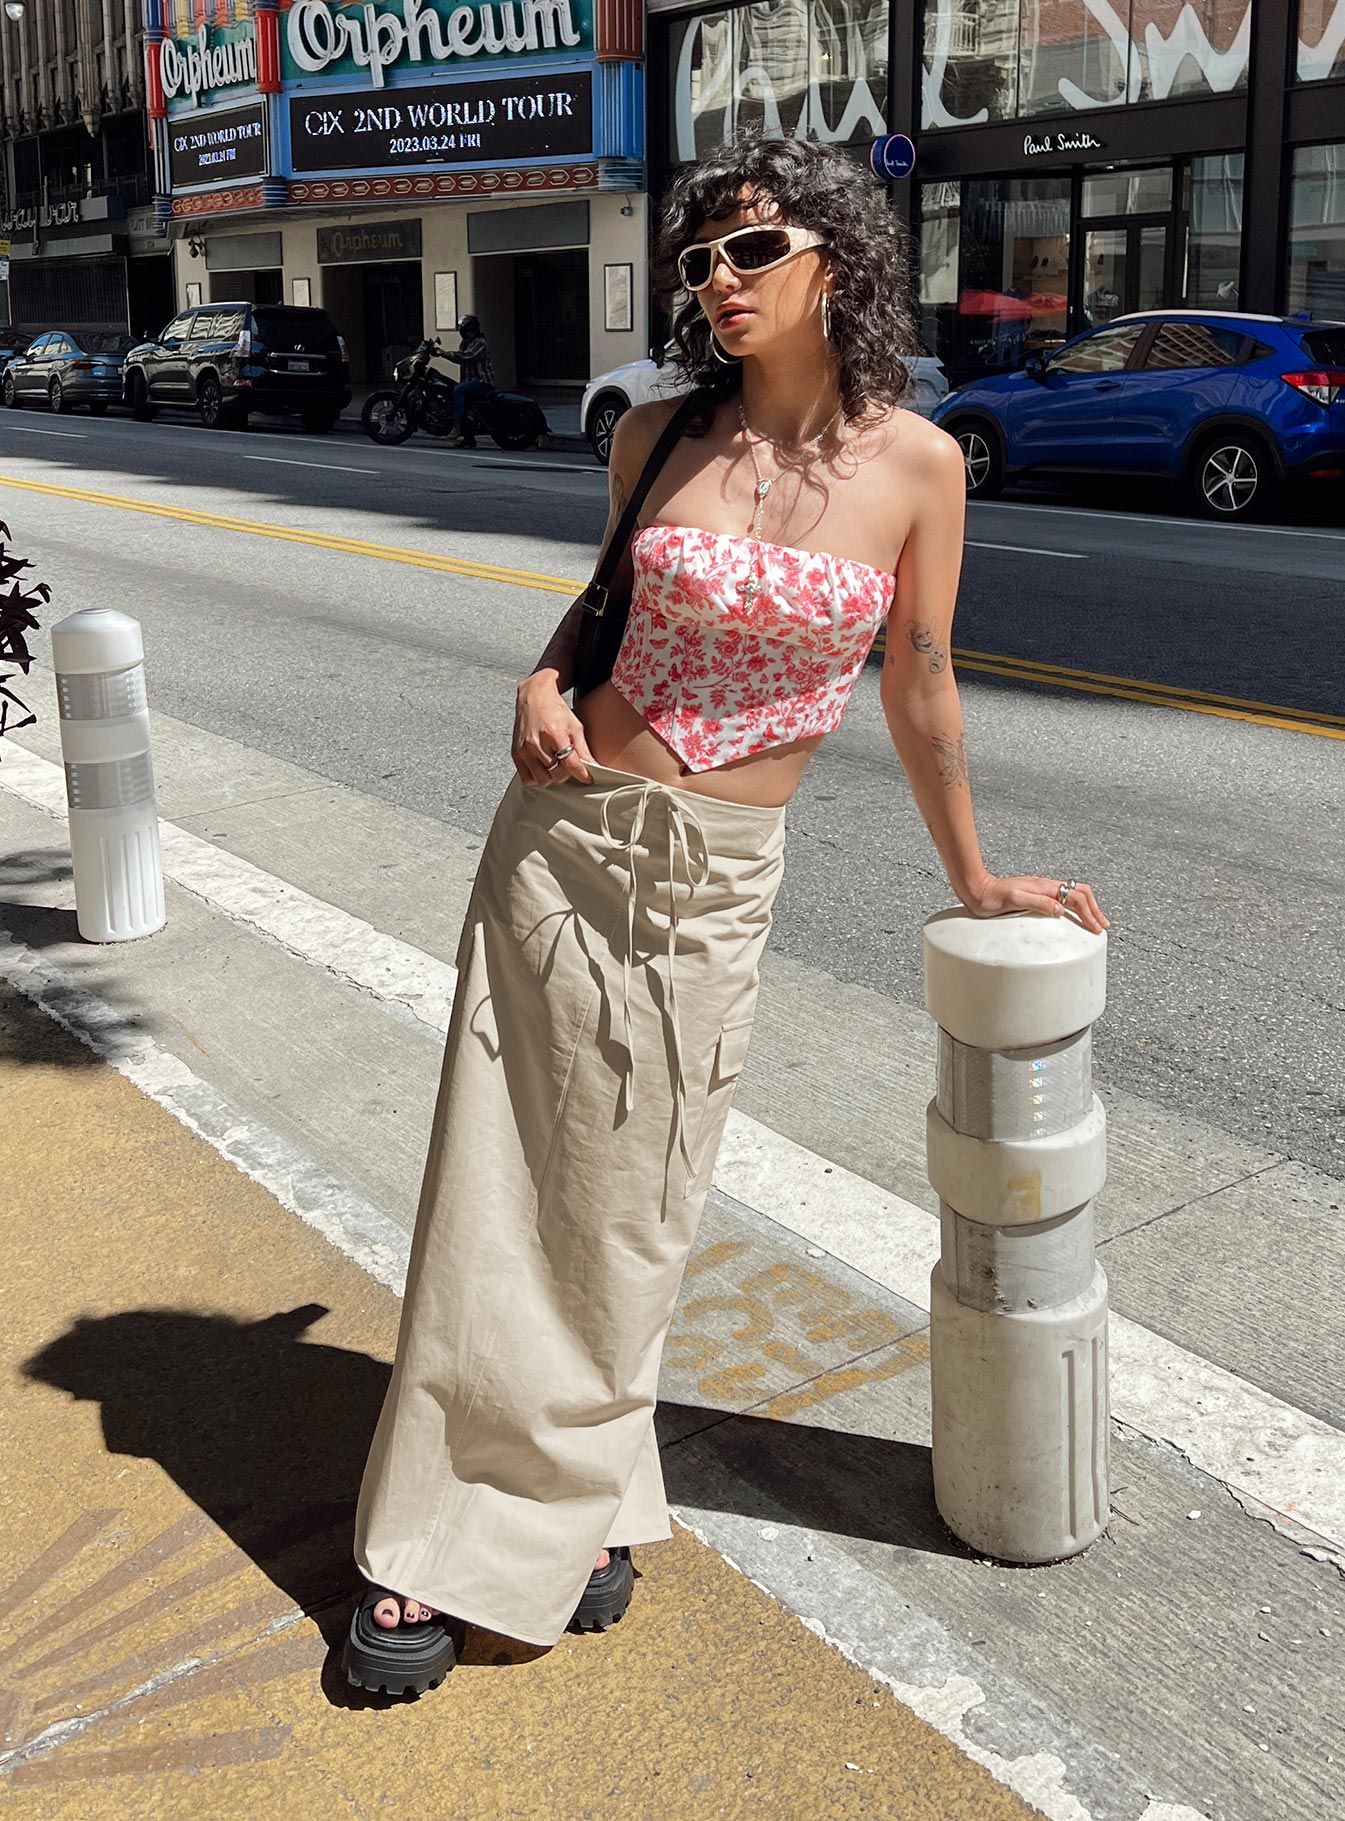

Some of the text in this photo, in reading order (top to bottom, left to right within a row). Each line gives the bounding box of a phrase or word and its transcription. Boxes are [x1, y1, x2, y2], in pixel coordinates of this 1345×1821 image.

[287, 0, 580, 88] Orpheum
[161, 24, 256, 108] Orpheum
[304, 92, 573, 136] CIX 2ND WORLD TOUR
[389, 133, 481, 154] 2023.03.24 FRI
[1023, 133, 1100, 155] Paul Smith
[332, 229, 403, 257] Orpheum
